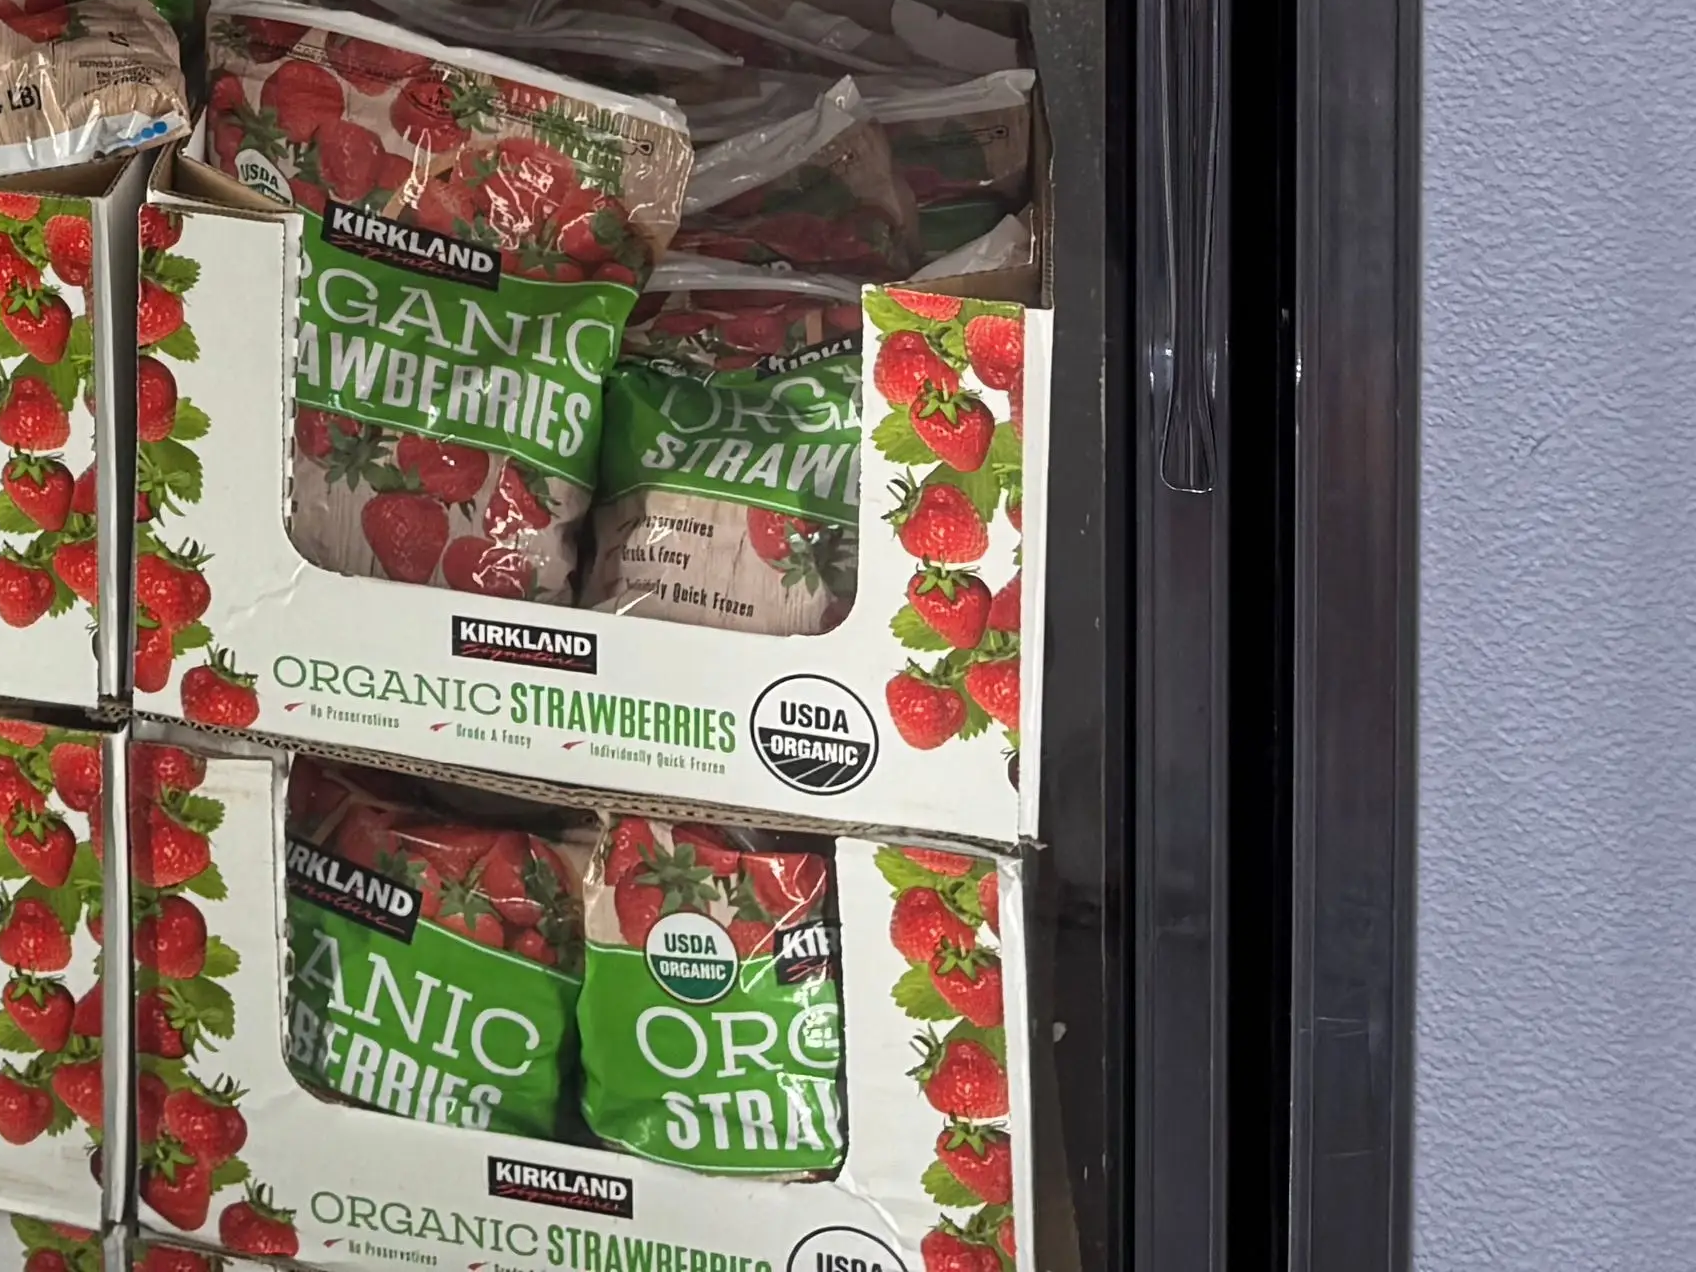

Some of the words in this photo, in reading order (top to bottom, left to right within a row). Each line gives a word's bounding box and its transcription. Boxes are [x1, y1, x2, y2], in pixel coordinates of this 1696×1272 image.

[10, 84, 43, 117] LB)
[333, 208, 494, 274] KIRKLAND
[459, 621, 592, 657] KIRKLAND
[272, 655, 503, 715] ORGANIC
[510, 688, 737, 753] STRAWBERRIES
[780, 700, 851, 735] USDA
[770, 733, 858, 766] ORGANIC
[663, 932, 717, 959] USDA
